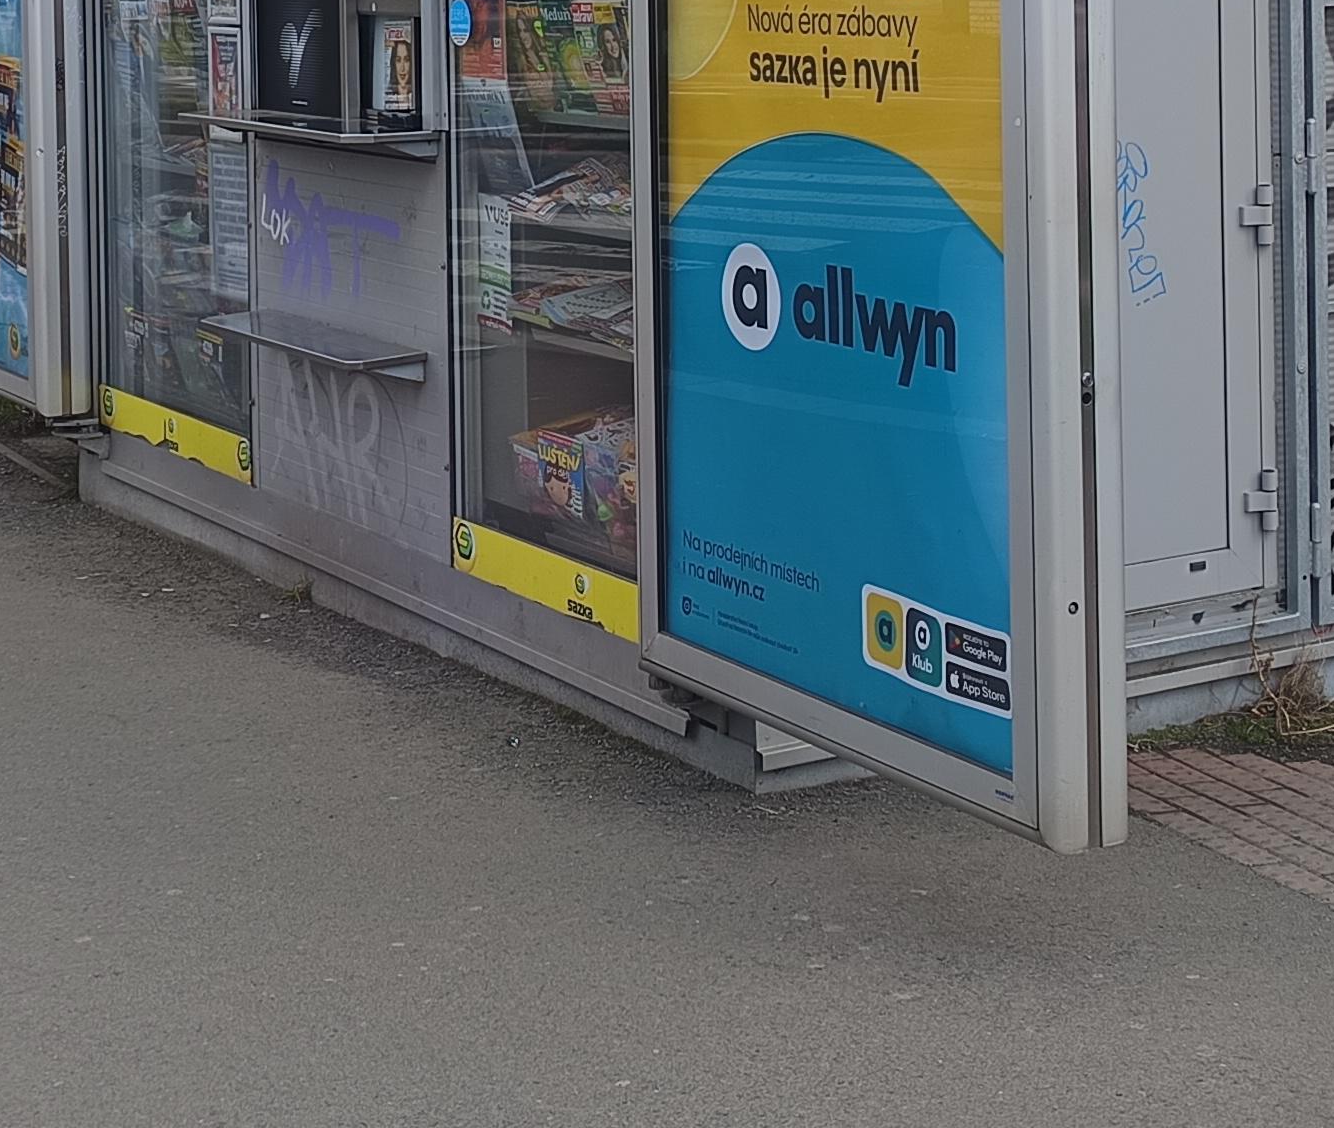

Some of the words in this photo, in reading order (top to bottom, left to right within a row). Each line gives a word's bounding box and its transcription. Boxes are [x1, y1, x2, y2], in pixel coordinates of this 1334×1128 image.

[747, 3, 793, 34] Nová
[798, 7, 833, 36] éra
[836, 6, 918, 47] zábavy
[749, 50, 817, 86] sazka
[823, 45, 847, 98] je
[854, 49, 920, 104] nyní
[261, 193, 292, 246] LOK
[792, 264, 958, 388] allwyn
[683, 529, 701, 551] Na
[703, 539, 768, 574] prodejních
[770, 560, 820, 593] místech
[689, 563, 705, 580] na
[707, 567, 765, 602] allwyn.cz
[568, 599, 593, 620] sazka
[912, 652, 933, 675] Klub
[963, 641, 987, 660] Google
[987, 650, 1003, 667] Play
[963, 680, 981, 697] App
[982, 685, 1006, 703] Store
